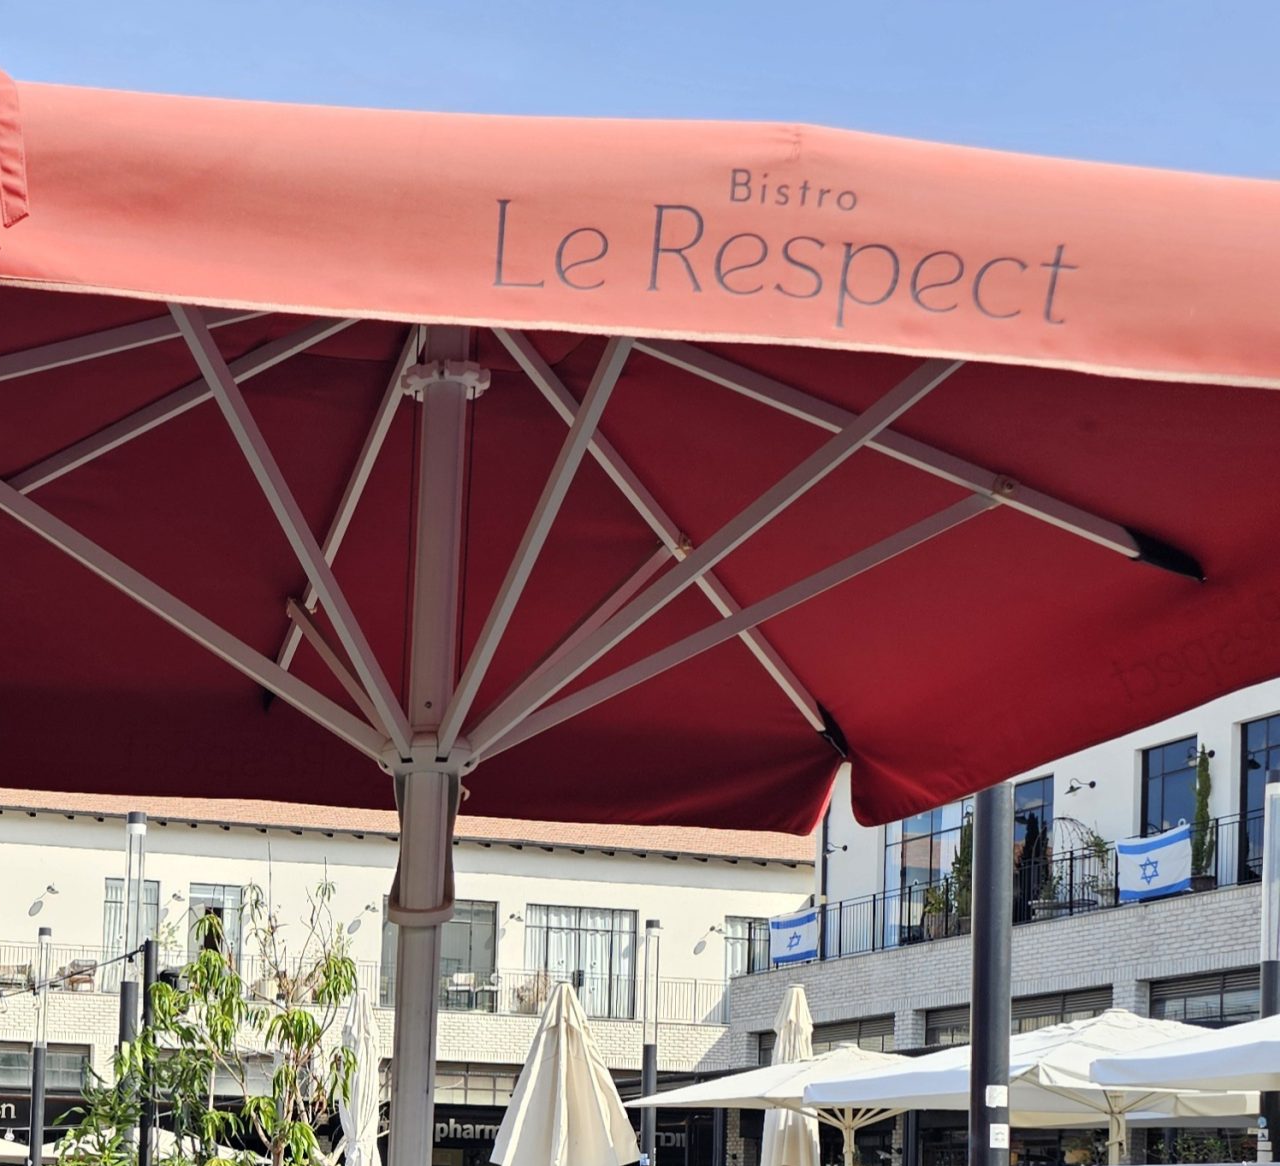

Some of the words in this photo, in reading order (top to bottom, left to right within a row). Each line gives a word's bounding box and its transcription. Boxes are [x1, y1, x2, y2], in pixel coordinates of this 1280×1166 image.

[729, 168, 858, 212] Bistro
[492, 198, 609, 291] Le
[646, 203, 1080, 329] Respect
